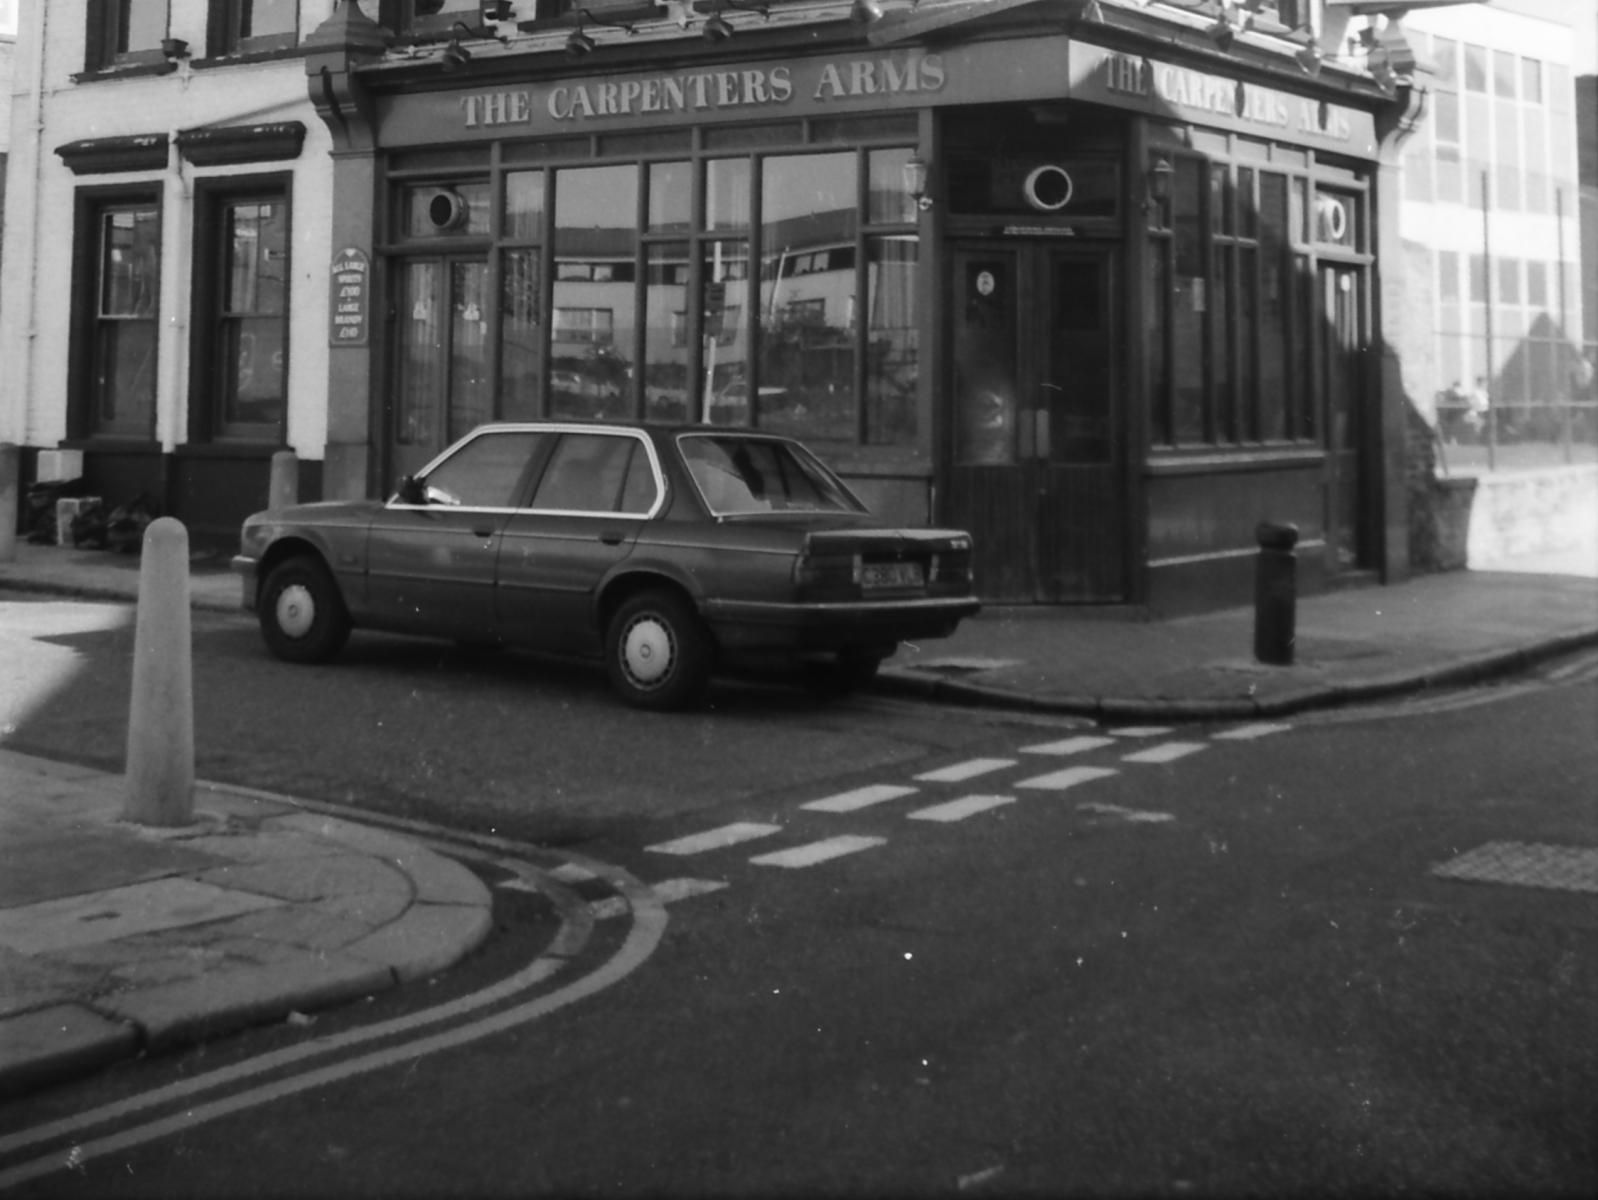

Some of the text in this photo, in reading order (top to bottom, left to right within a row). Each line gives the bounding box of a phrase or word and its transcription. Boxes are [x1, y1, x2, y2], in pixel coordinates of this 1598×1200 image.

[460, 53, 947, 128] THE CARPENTERS ARMS
[1104, 53, 1148, 96] THE
